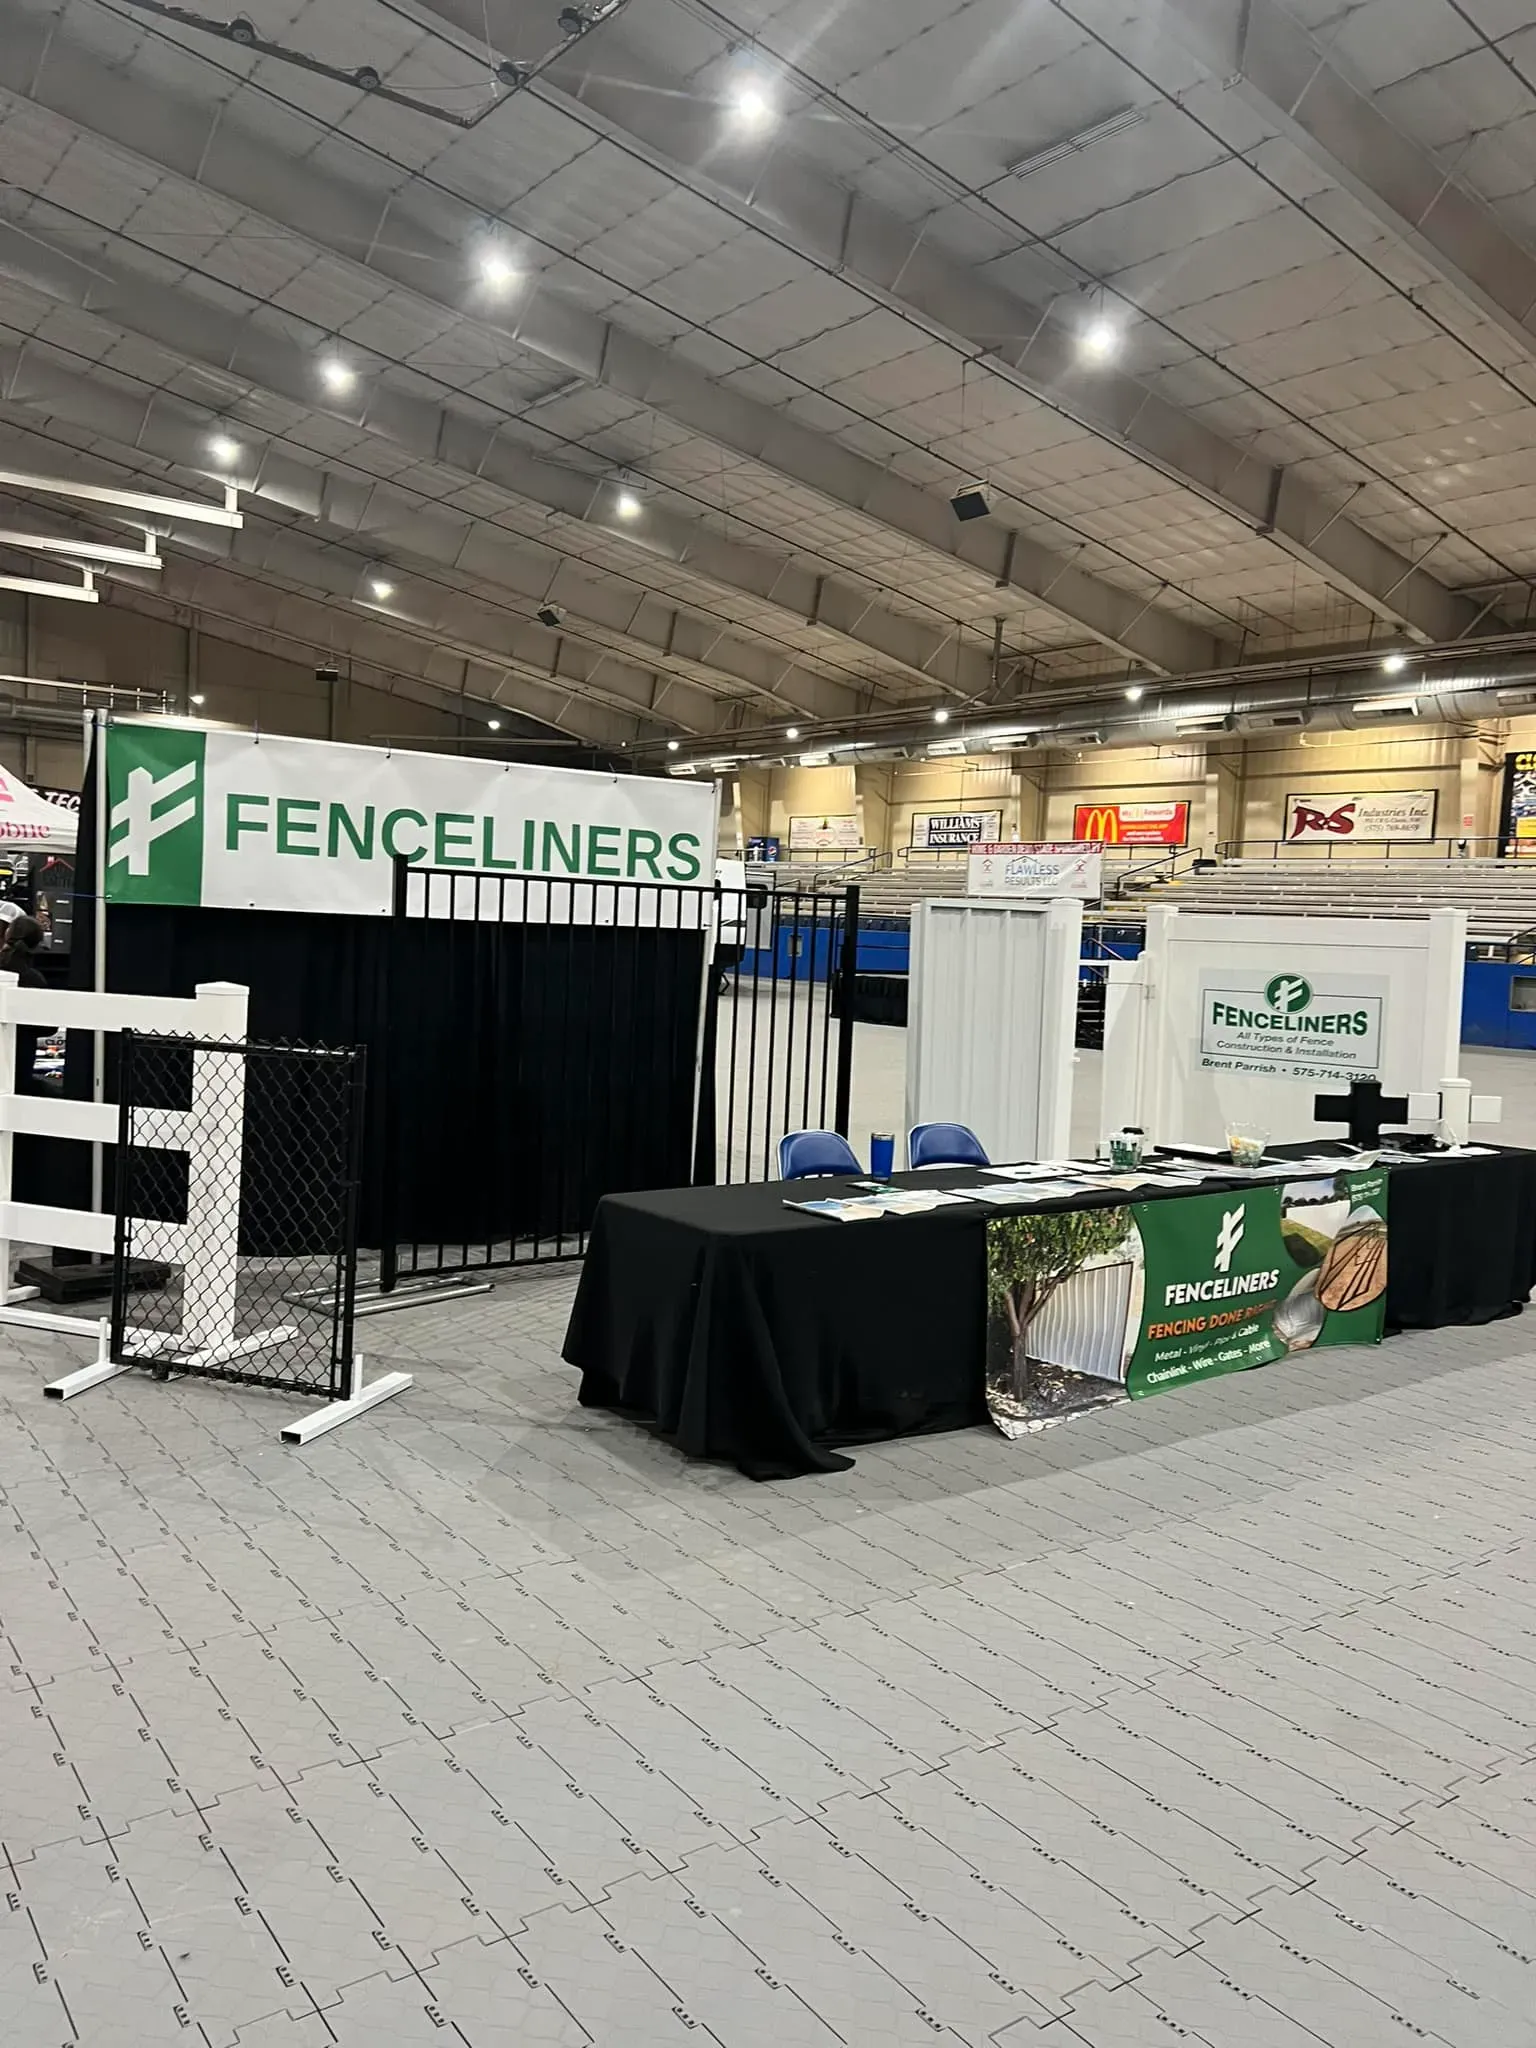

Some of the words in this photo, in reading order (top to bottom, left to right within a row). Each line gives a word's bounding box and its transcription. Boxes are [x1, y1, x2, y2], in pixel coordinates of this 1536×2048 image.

[930, 816, 982, 830] WILLIAMS
[1358, 807, 1406, 817] Industries
[226, 793, 701, 881] FENCELINERS
[929, 833, 980, 844] INSURANCE
[1004, 864, 1060, 875] FLAWLESS
[1004, 876, 1040, 886] RESULTS
[1212, 1001, 1369, 1036] FENCELINERS
[1216, 1040, 1284, 1054] Construction
[1285, 1045, 1293, 1054] &
[1296, 1046, 1357, 1060] Installation
[1236, 1031, 1250, 1040] All
[1253, 1032, 1284, 1043] Types
[1286, 1035, 1298, 1043] of
[1300, 1036, 1335, 1047] Fence
[1201, 1057, 1233, 1069] Brent
[1234, 1061, 1277, 1073] Parrish
[1292, 1066, 1377, 1082] 575-714-3120
[1164, 1269, 1280, 1307] FENCELINERS
[1147, 1316, 1207, 1340] FENCING
[1209, 1310, 1245, 1328] DONE
[1154, 1348, 1183, 1362] Metal
[1238, 1323, 1260, 1337] Cable
[1146, 1365, 1188, 1384] Chainlink
[1192, 1357, 1214, 1371] Wire
[1217, 1349, 1243, 1363] Gates
[1248, 1339, 1272, 1354] More
